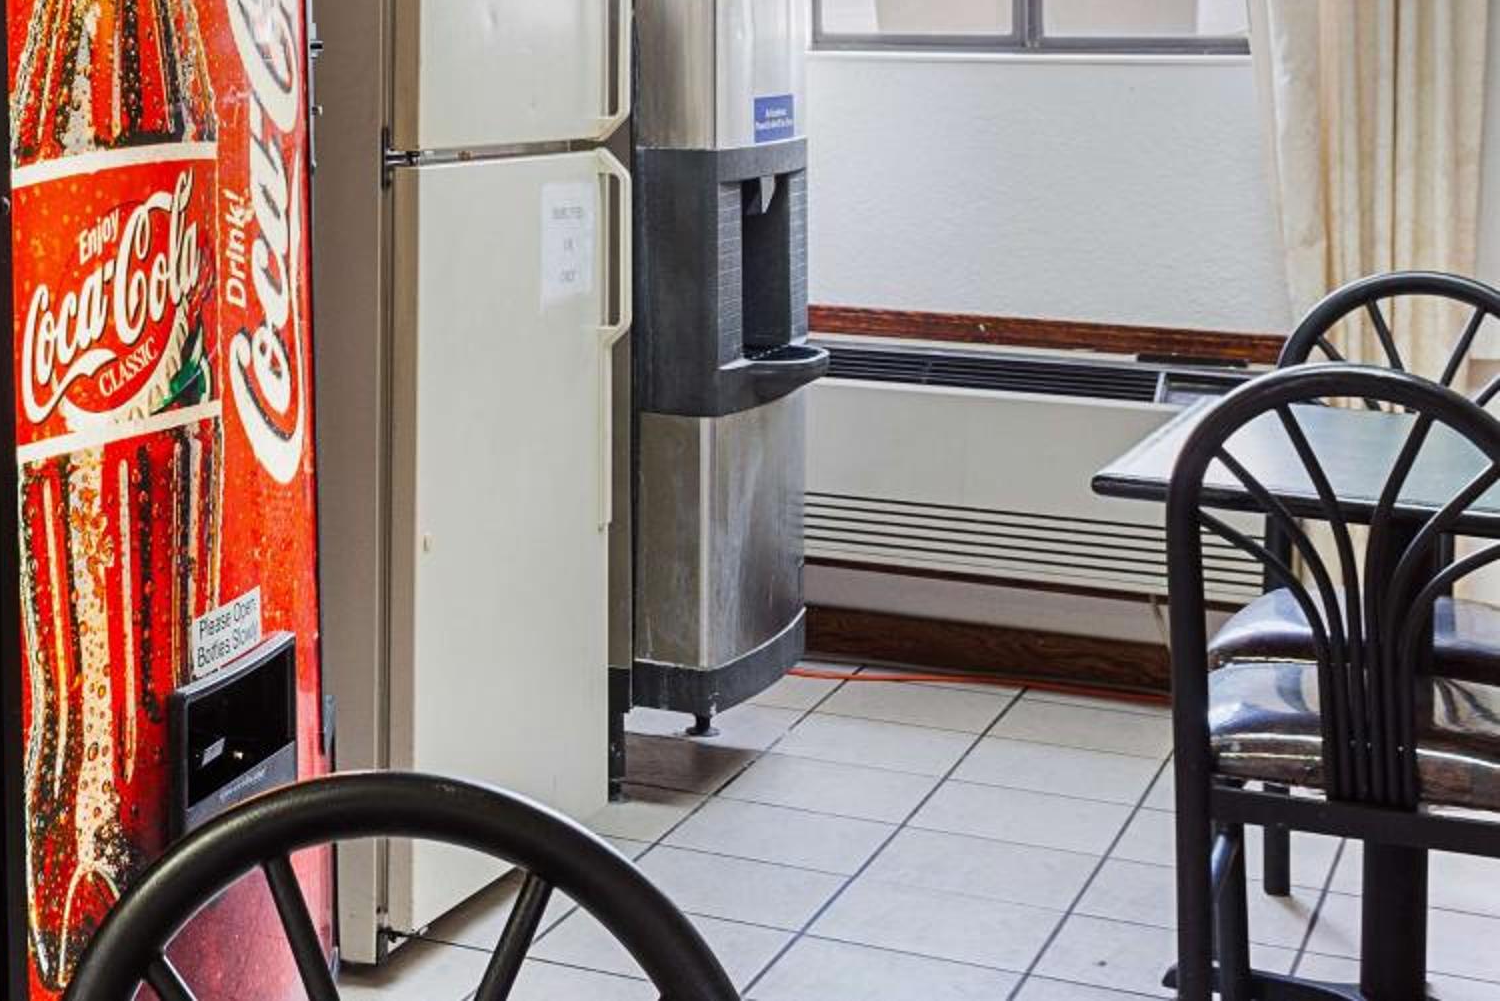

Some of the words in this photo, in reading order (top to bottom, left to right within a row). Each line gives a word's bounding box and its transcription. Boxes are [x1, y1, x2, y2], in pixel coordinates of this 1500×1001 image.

[79, 209, 120, 265] Enjoy
[226, 188, 251, 307] Drink!
[22, 167, 200, 423] Coca-Cola
[99, 336, 158, 397] CLASSIC
[197, 637, 231, 668] Bottles
[199, 611, 231, 641] Please
